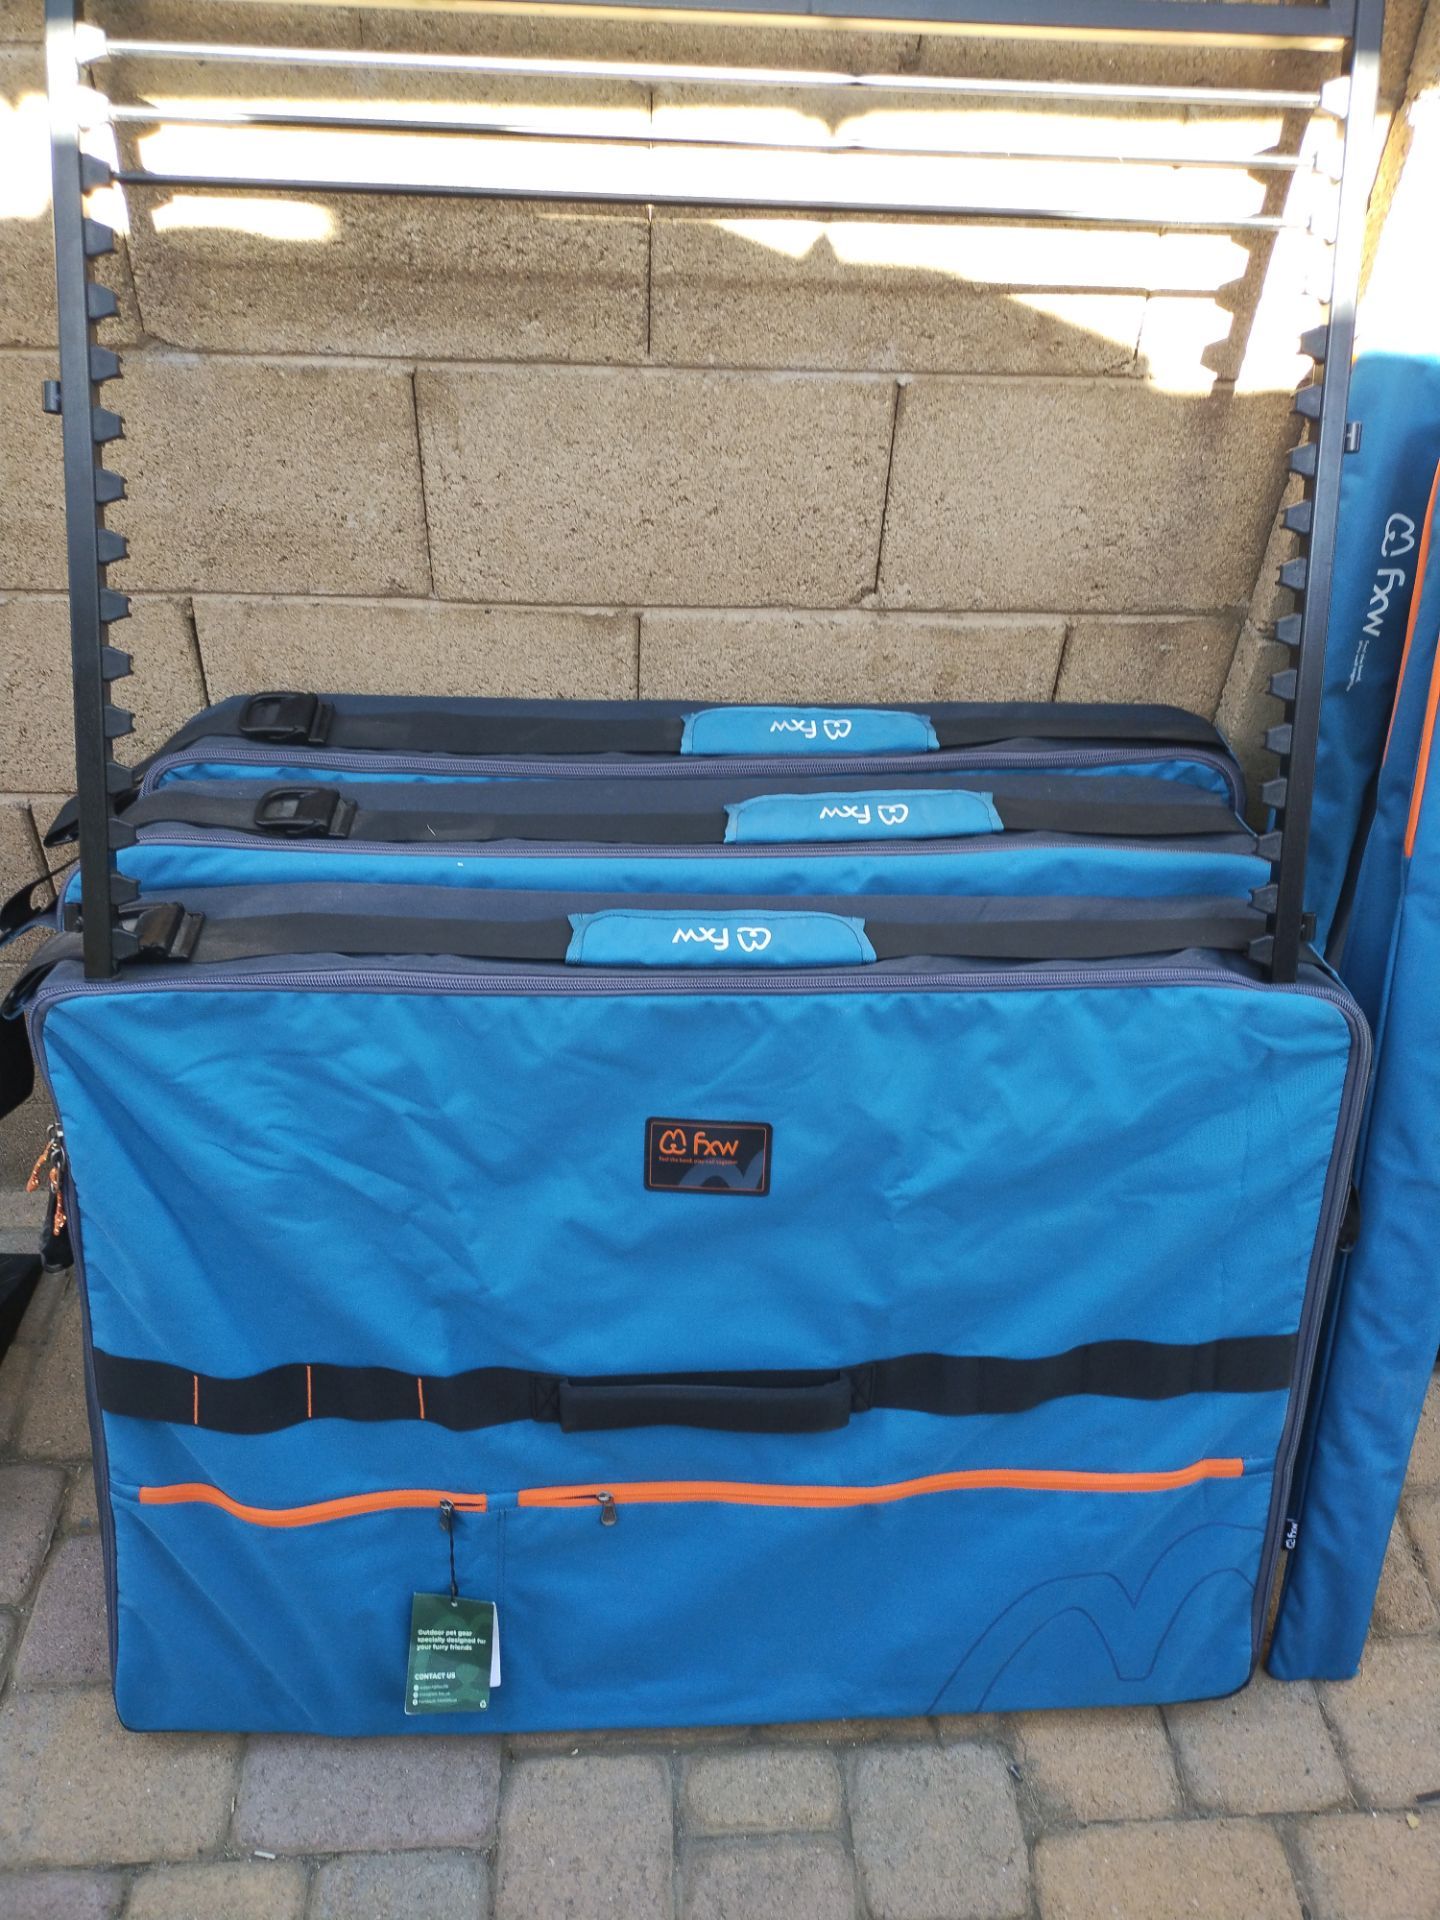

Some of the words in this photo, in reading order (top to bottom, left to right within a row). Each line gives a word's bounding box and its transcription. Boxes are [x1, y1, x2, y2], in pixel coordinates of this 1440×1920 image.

[1362, 568, 1406, 637] fxw
[770, 719, 817, 739] fxw
[820, 804, 871, 825] fxw
[671, 926, 729, 951] fxw
[694, 1131, 739, 1156] fxw
[446, 1637, 476, 1645] designed
[414, 1672, 445, 1680] CONTACT
